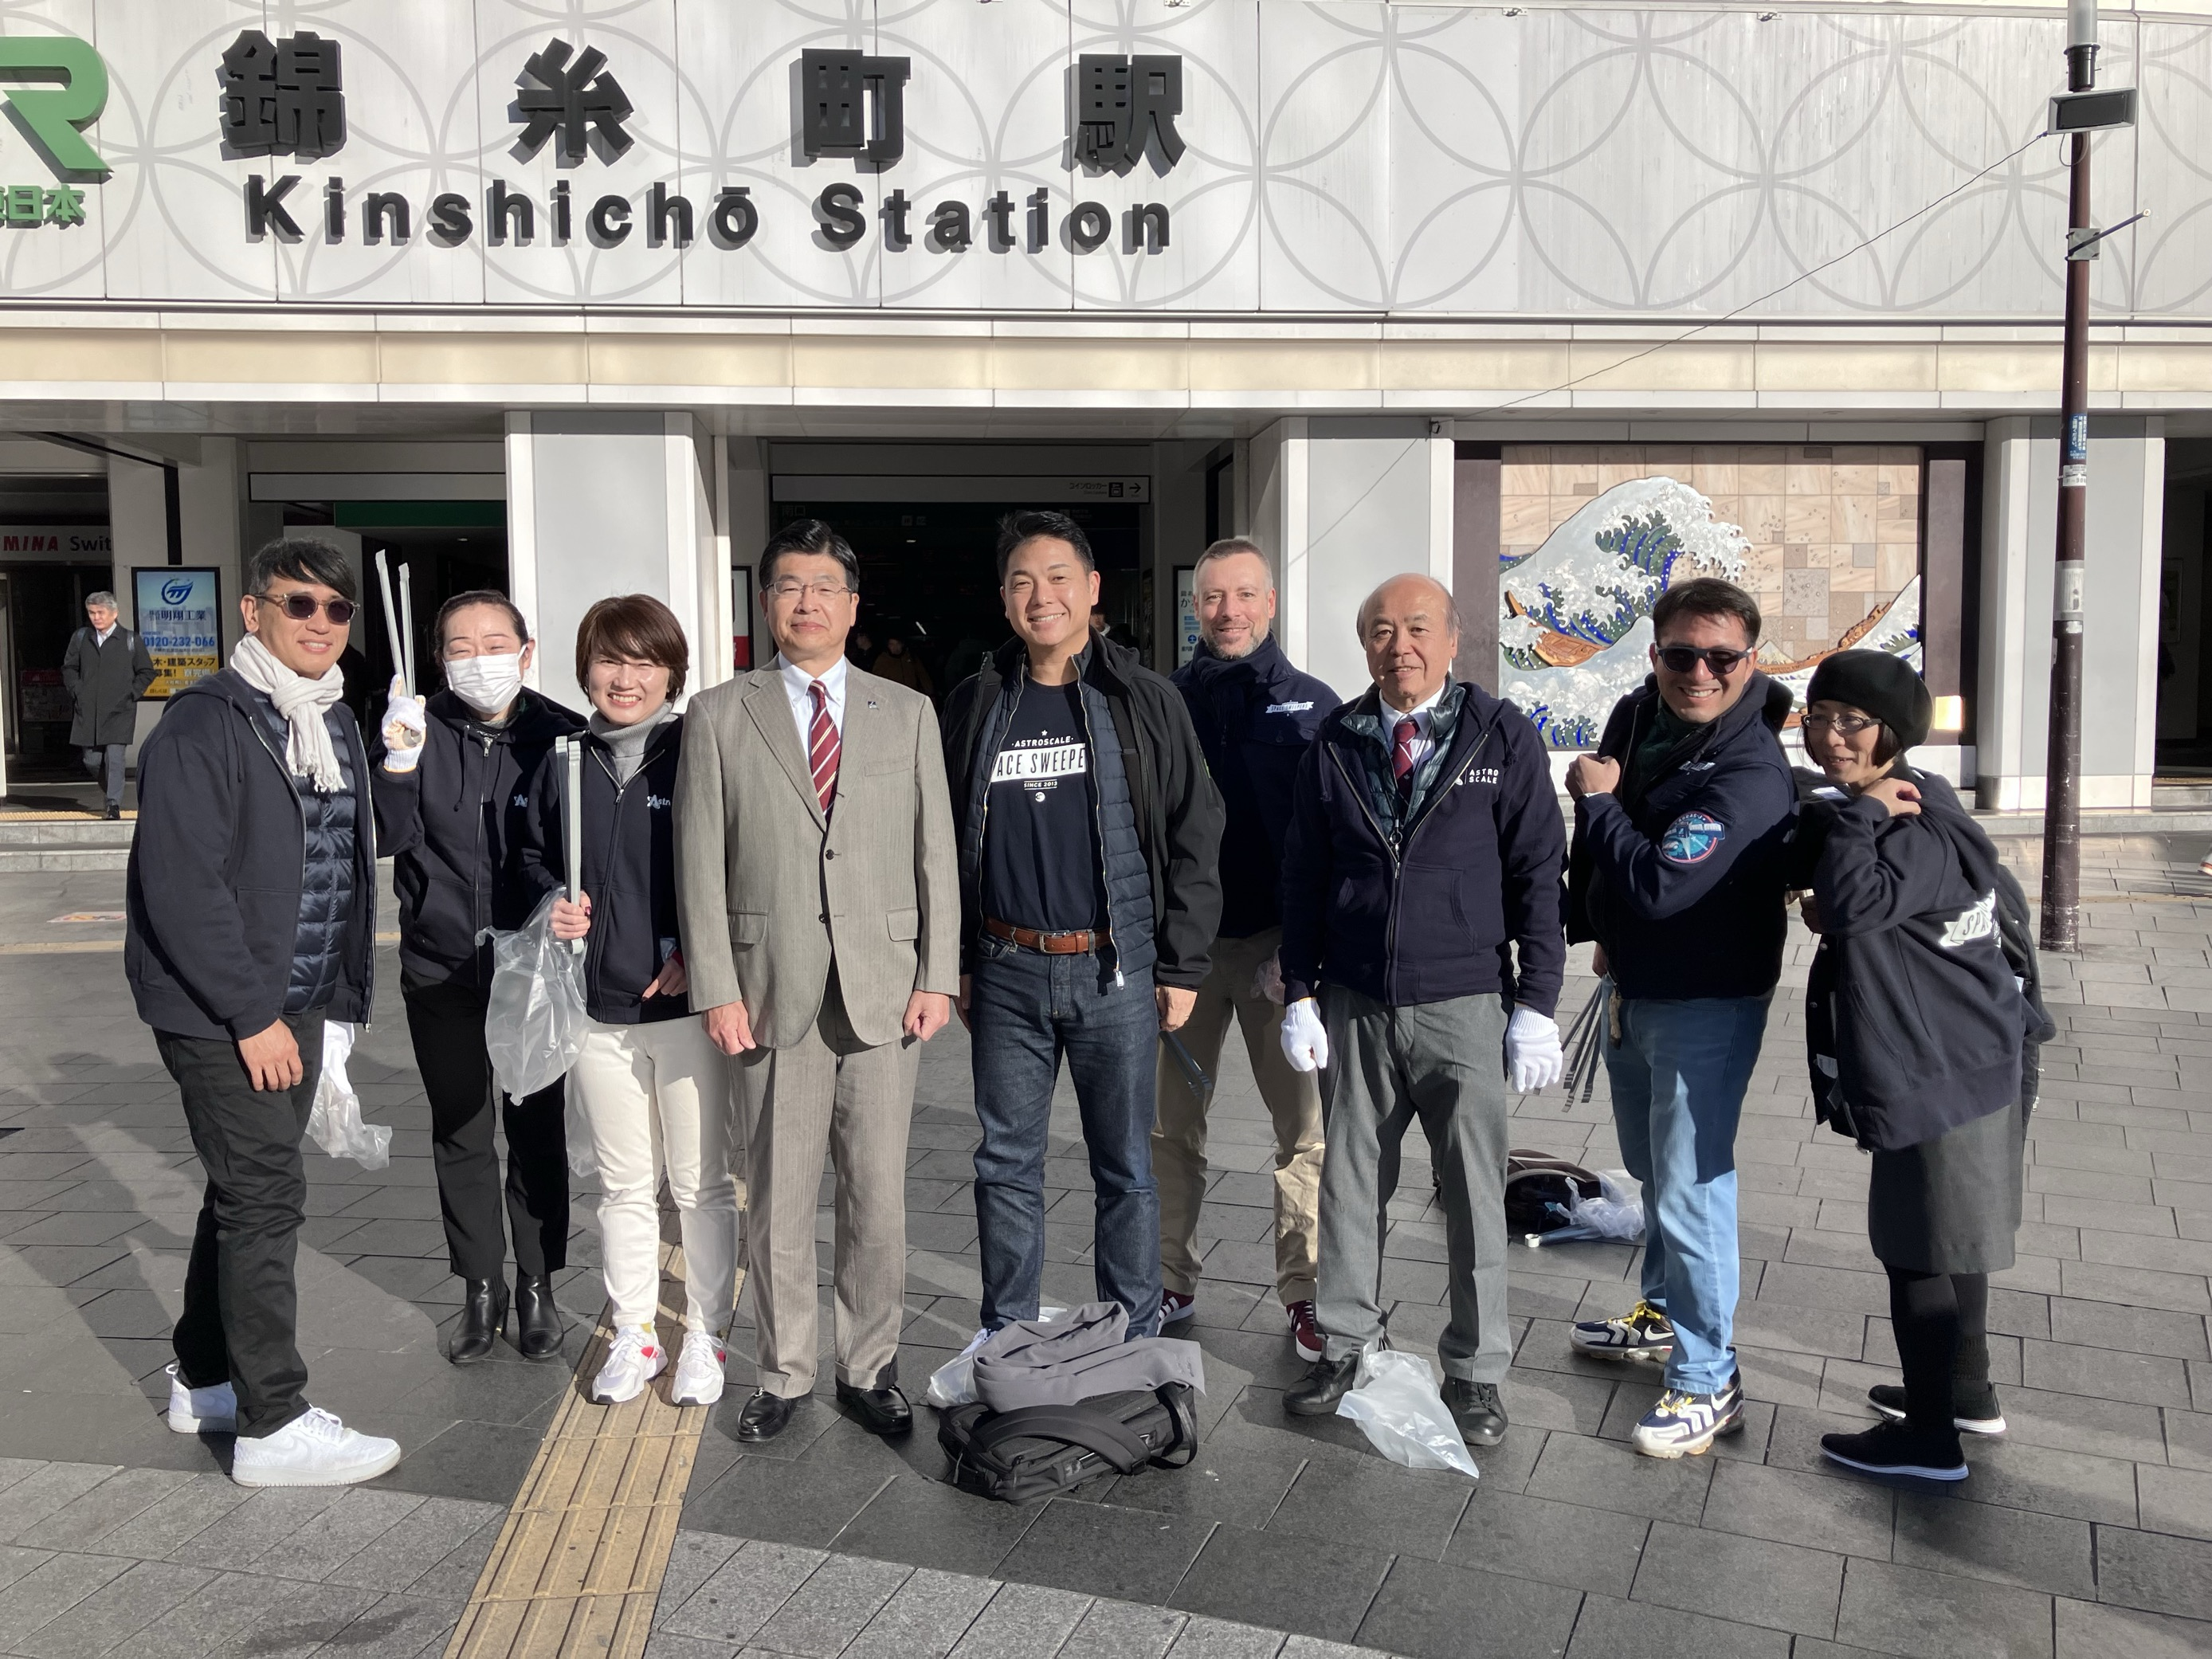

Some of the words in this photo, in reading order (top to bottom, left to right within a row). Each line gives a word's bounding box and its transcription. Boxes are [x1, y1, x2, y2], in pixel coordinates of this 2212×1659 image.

[220, 30, 1186, 178] 錦糸町駅
[0, 184, 86, 222] 日本
[245, 175, 759, 246] Kinshichō
[818, 182, 1170, 249] Station
[144, 637, 215, 647] 0120-232-066
[1014, 736, 1071, 747] ASTROSCALE
[1469, 768, 1499, 777] ASTRO
[1469, 775, 1497, 784] SCALE
